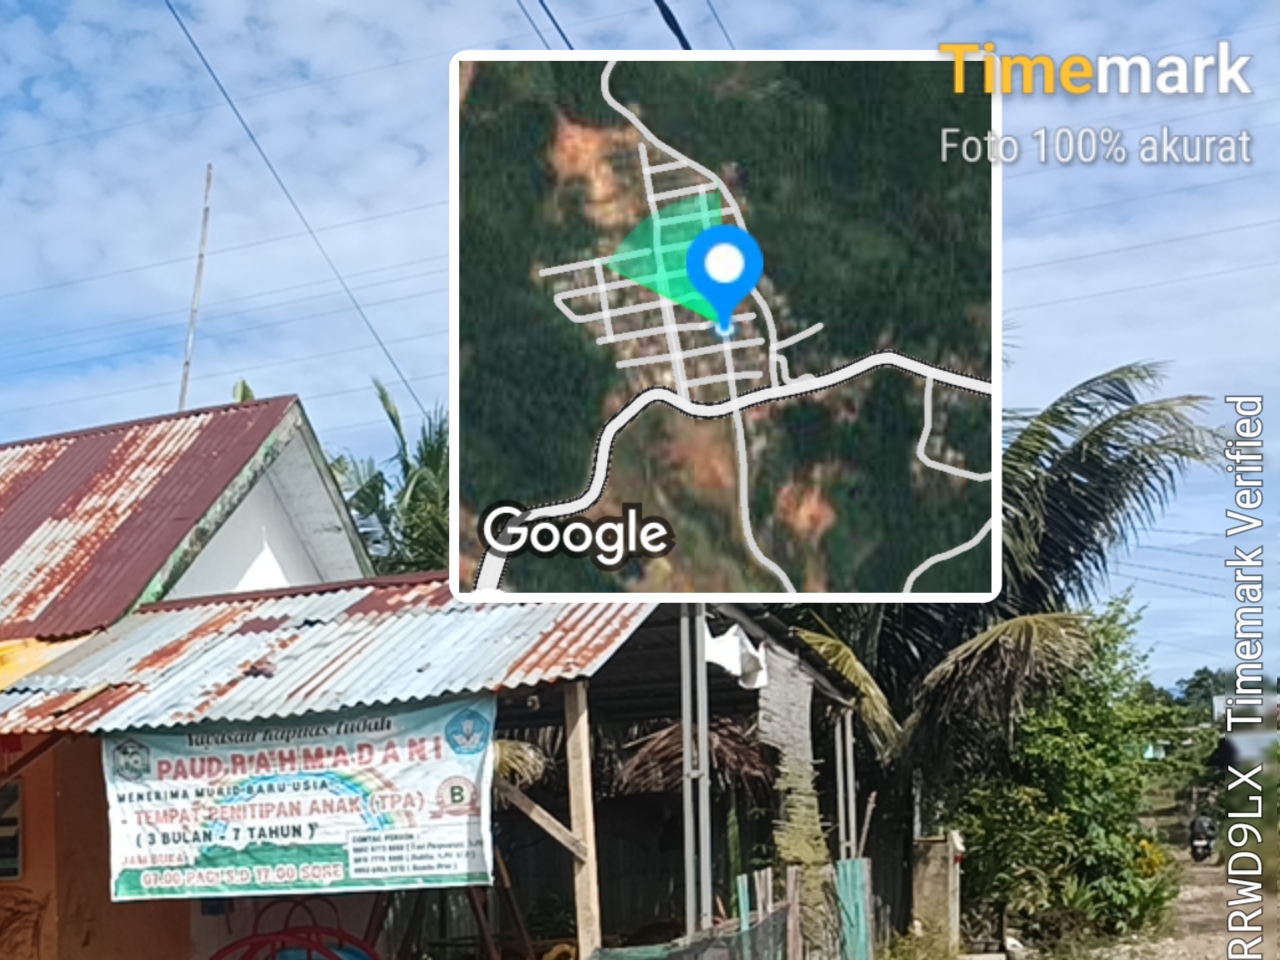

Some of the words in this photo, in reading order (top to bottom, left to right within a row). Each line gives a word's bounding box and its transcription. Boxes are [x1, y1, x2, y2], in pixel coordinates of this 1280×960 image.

[157, 756, 222, 780] PAUD
[117, 790, 190, 803] MENERIMA
[194, 786, 240, 797] MURID
[246, 782, 288, 792] BARU
[292, 780, 329, 791] USIA
[450, 786, 464, 803] B
[135, 807, 203, 826] TEMPAT
[208, 801, 302, 820] PENITIPAN
[309, 797, 362, 815] ANAK
[369, 790, 426, 814] (TPA)
[148, 833, 156, 845] 3
[162, 831, 212, 845] BULAN
[232, 828, 241, 840] 7
[247, 825, 302, 839] TAHUN
